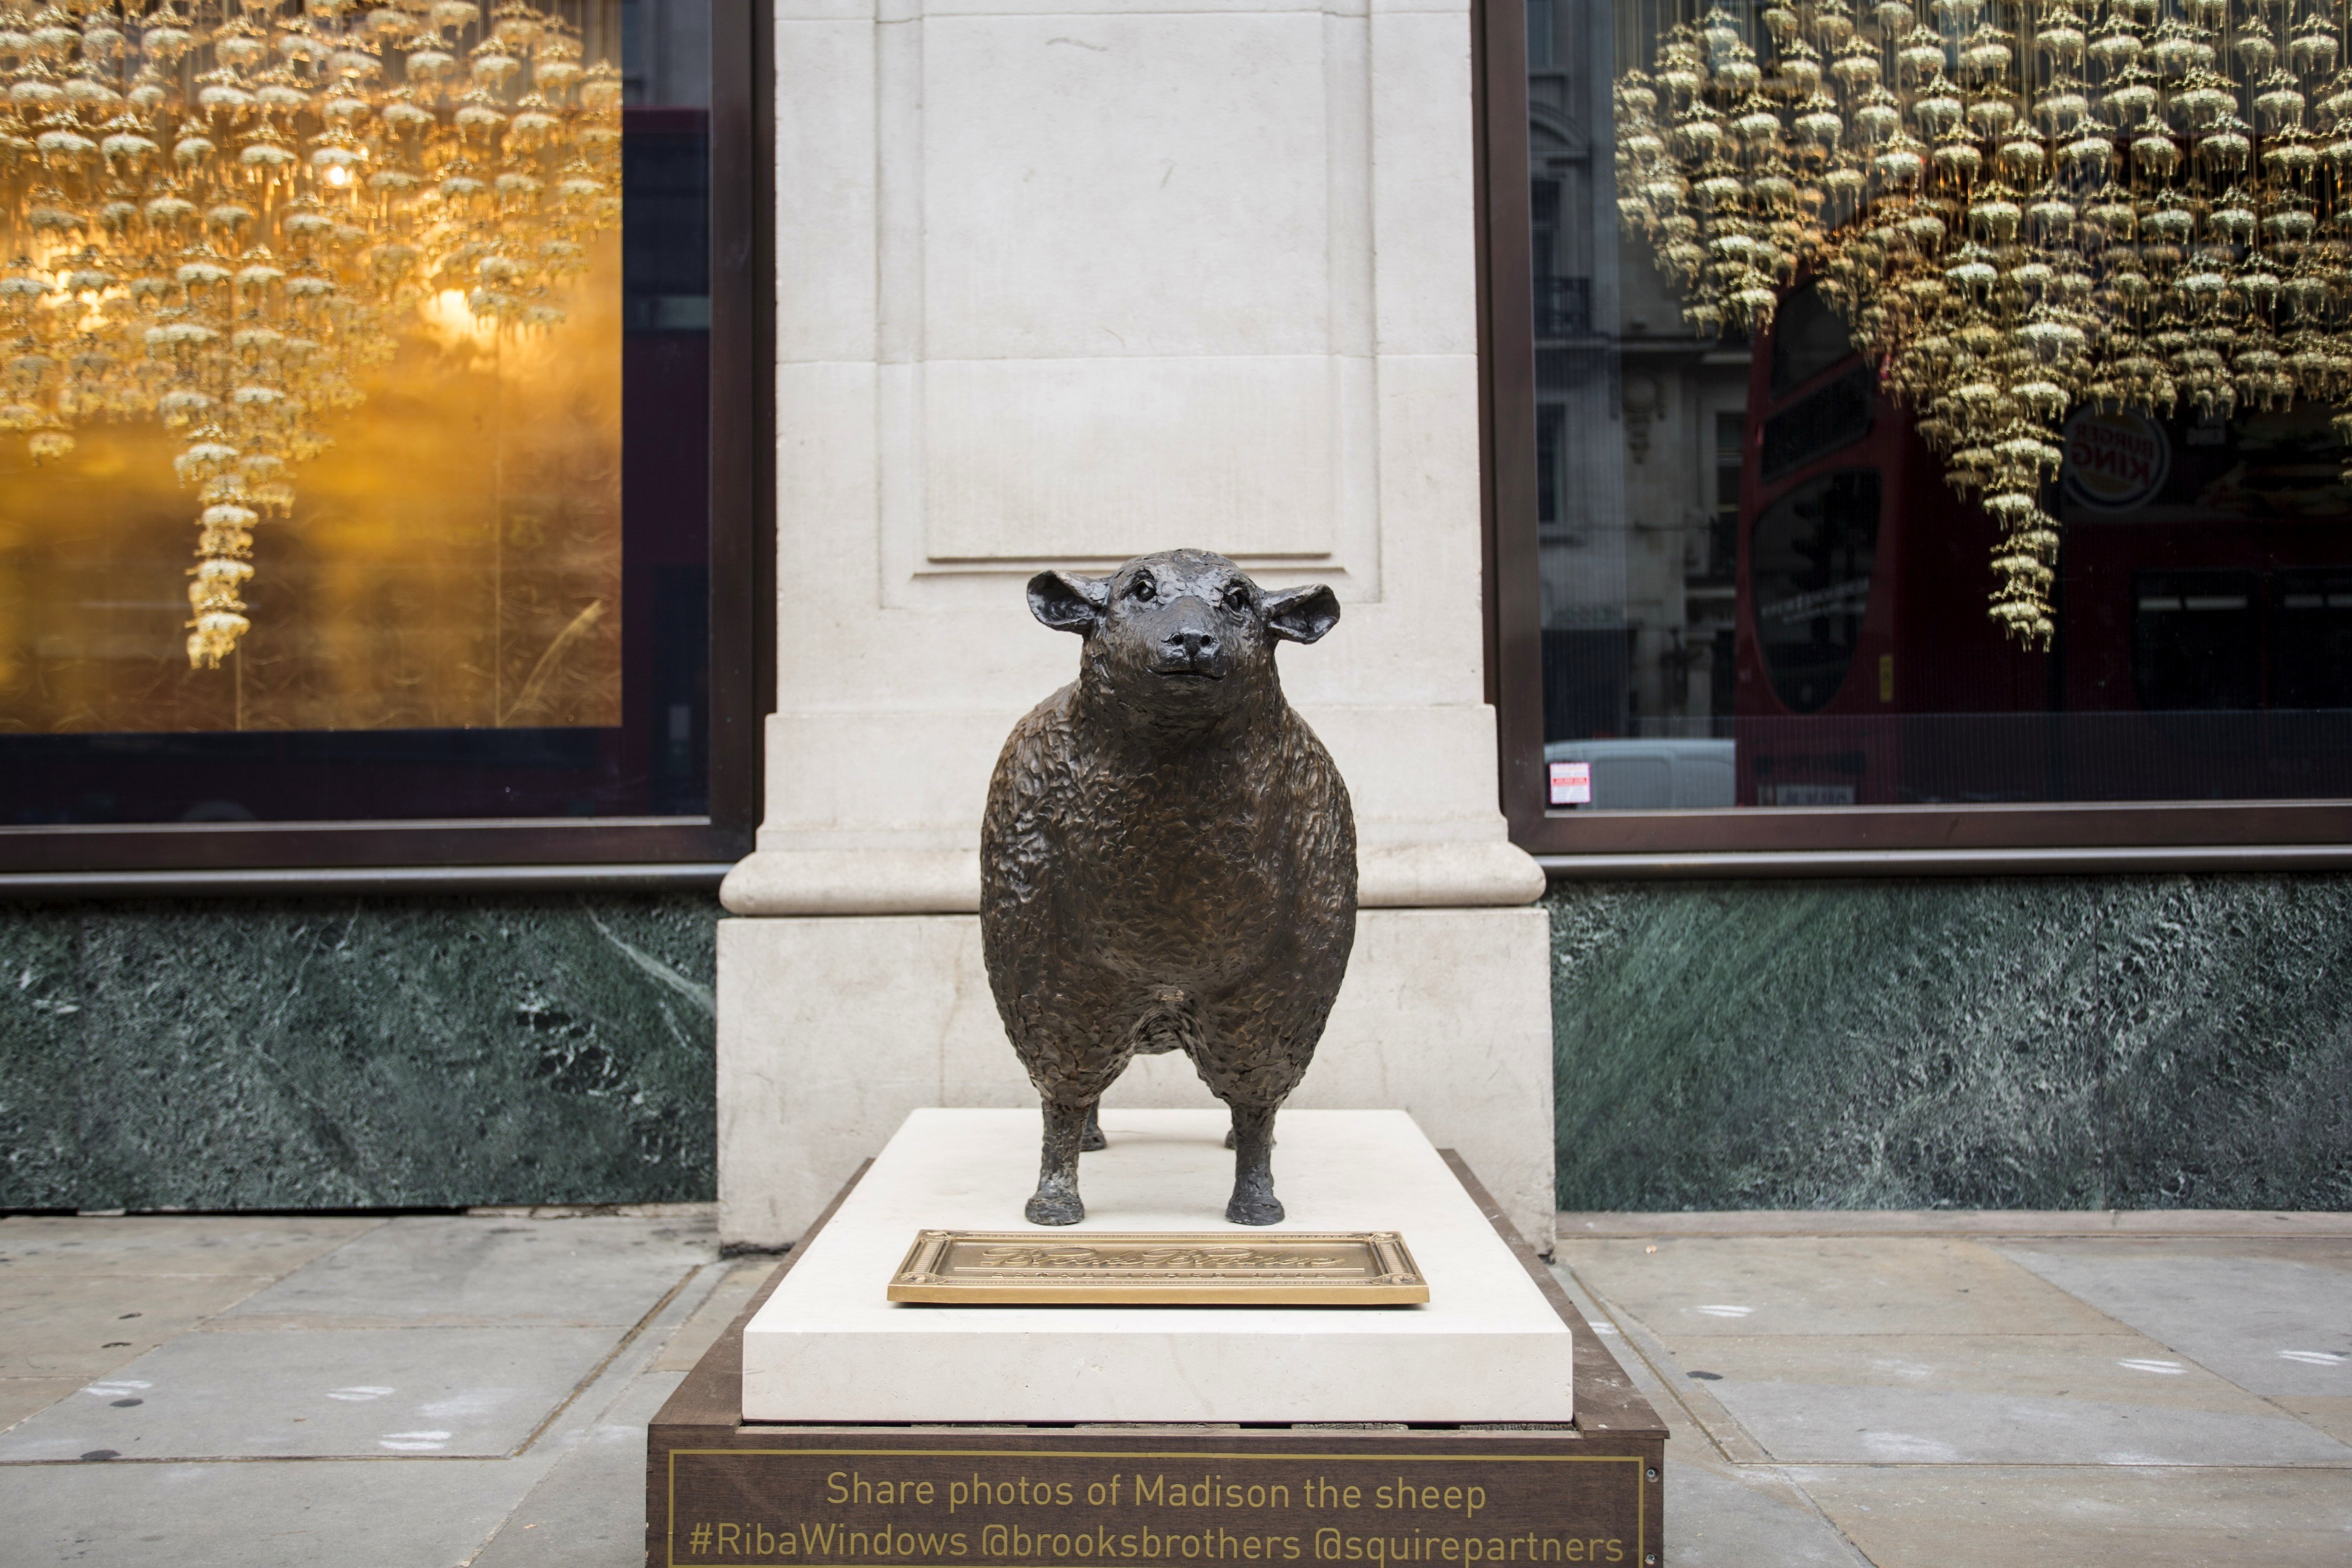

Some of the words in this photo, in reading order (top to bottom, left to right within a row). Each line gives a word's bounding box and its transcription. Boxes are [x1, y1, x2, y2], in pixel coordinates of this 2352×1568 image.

[827, 1471, 935, 1504] Share
[950, 1472, 1073, 1514] photos
[1087, 1474, 1121, 1506] of
[1135, 1474, 1289, 1508] Madison
[1303, 1476, 1362, 1508] the
[1376, 1476, 1486, 1518] sheep
[690, 1522, 968, 1556] #RibaWindows
[982, 1524, 1301, 1560] @brooksbrothers
[1315, 1527, 1623, 1568] @squirepartners
